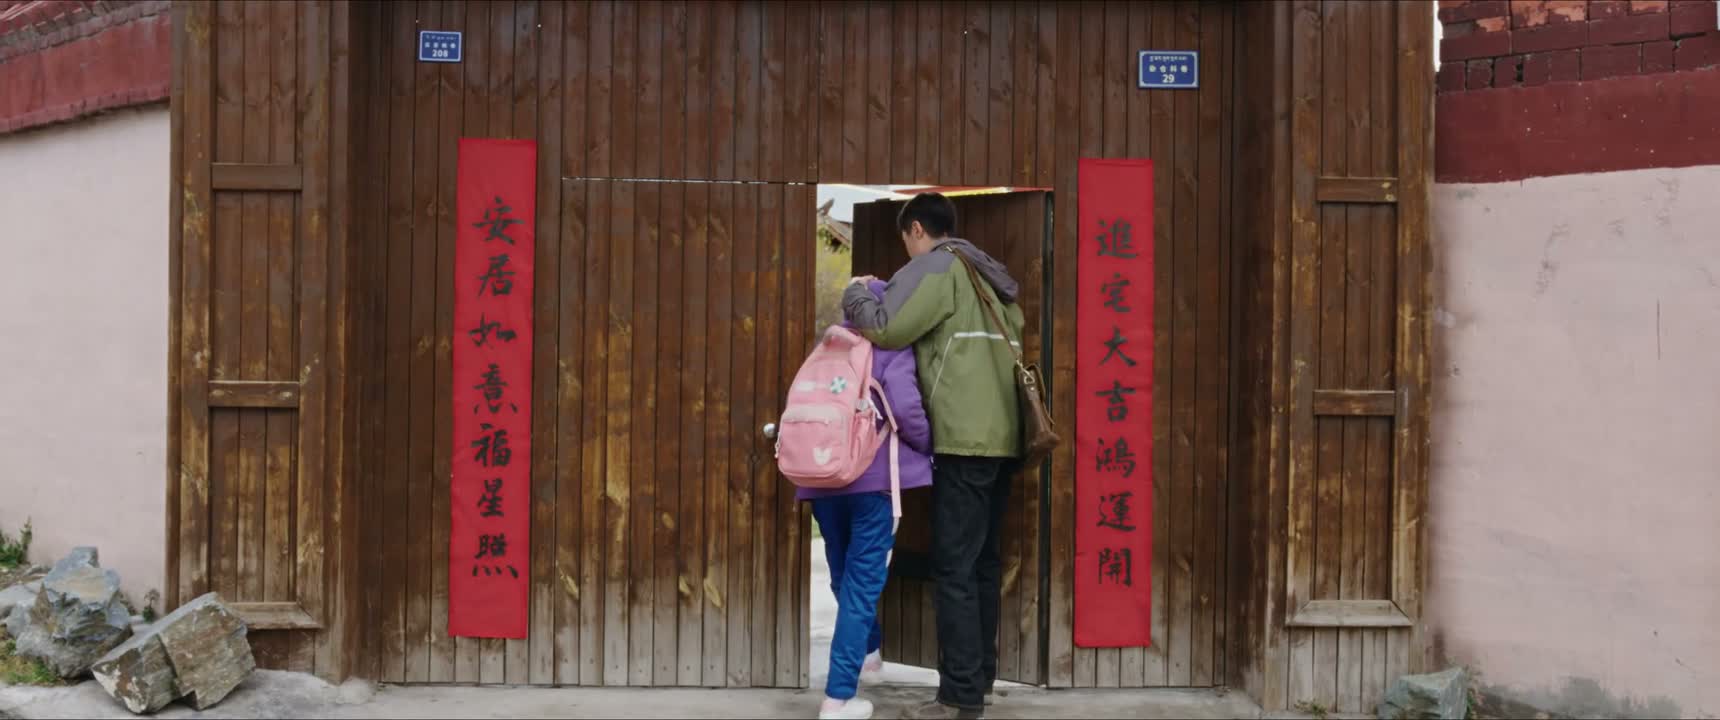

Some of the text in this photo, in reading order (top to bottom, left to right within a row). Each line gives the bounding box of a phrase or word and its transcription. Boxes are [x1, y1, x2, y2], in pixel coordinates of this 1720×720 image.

[432, 49, 449, 58] 208
[1162, 73, 1175, 83] 29
[468, 196, 524, 579] 安居如意福星照
